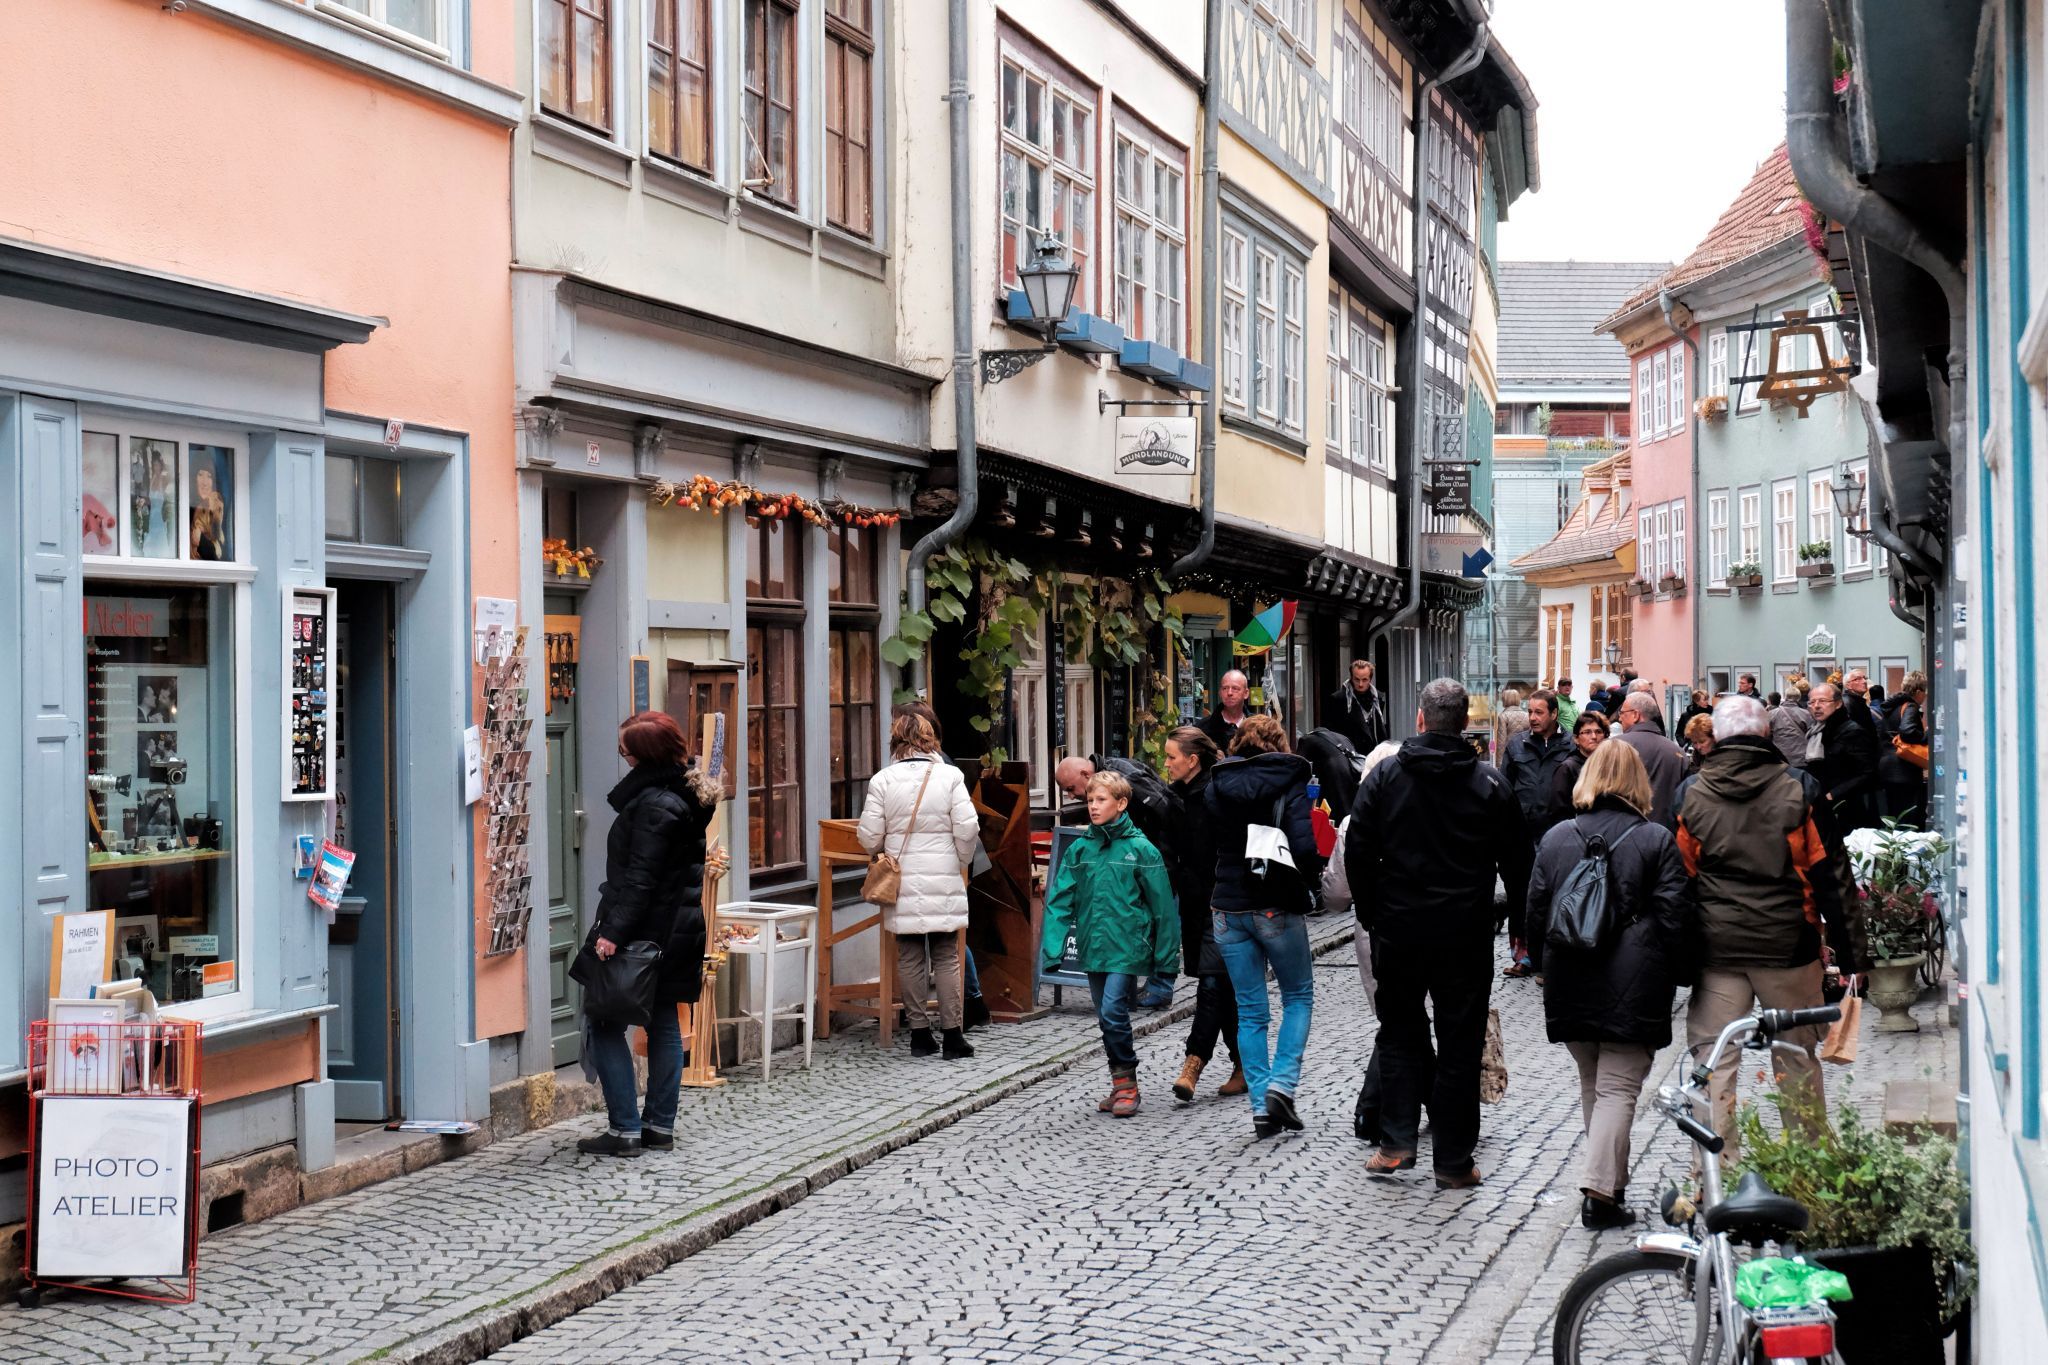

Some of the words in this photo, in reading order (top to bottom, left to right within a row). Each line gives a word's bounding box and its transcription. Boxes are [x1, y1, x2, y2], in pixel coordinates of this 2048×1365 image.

[389, 423, 401, 442] 26
[590, 444, 598, 462] 27
[1121, 450, 1187, 465] MUNDLANDUNG
[1440, 473, 1454, 481] Haus
[1448, 487, 1456, 497] &
[94, 599, 154, 637] Atelier
[69, 927, 99, 939] RAHMEN
[52, 1196, 178, 1216] ATELIER
